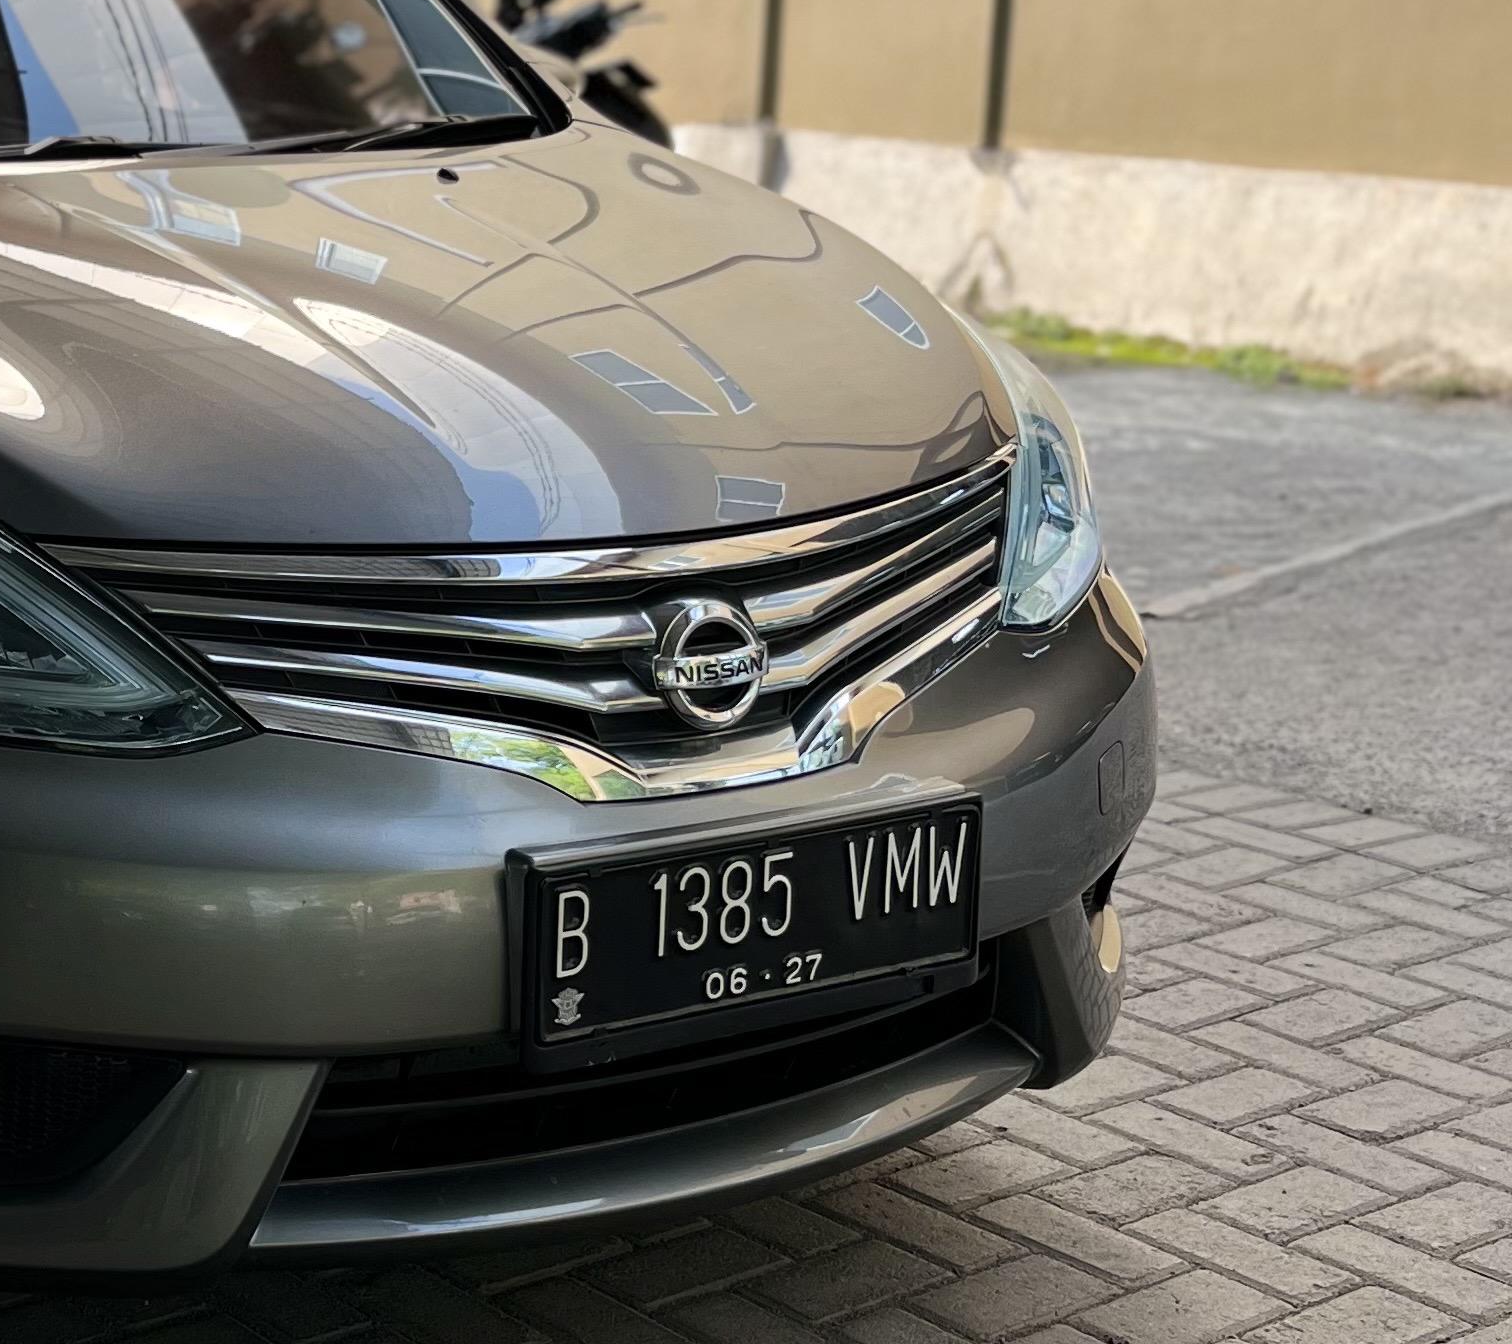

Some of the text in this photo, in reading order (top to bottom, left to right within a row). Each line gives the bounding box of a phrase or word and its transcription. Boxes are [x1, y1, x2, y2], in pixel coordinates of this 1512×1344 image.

[674, 656, 764, 684] NISSAN
[557, 822, 967, 977] B 1385 VMW
